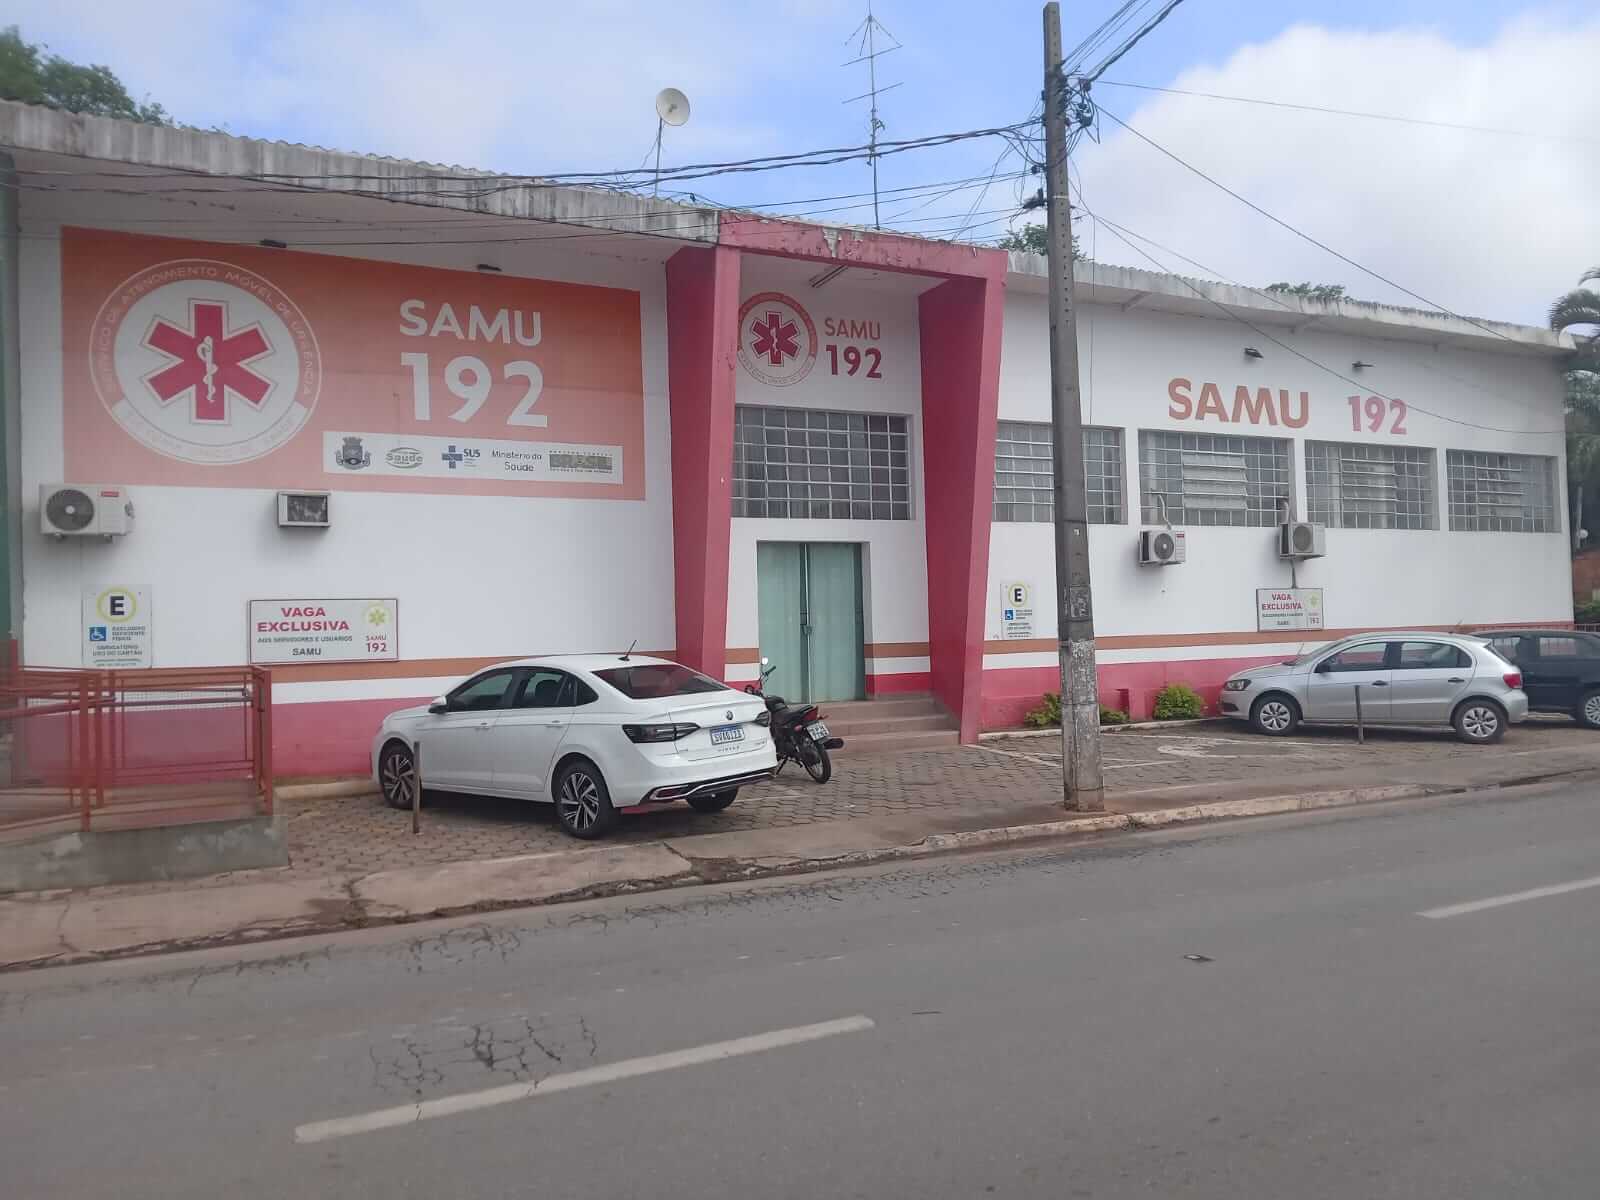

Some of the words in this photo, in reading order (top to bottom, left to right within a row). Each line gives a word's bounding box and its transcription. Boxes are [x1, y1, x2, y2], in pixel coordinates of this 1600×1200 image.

[400, 299, 542, 346] SAMU
[824, 317, 881, 340] SAMU
[825, 345, 882, 378] 192
[400, 352, 548, 428] 192
[1168, 377, 1309, 429] SAMU
[1348, 395, 1407, 435] 192
[463, 448, 480, 459] SUS
[1014, 588, 1022, 602] E
[110, 595, 125, 616] E
[281, 607, 326, 617] VAGA
[1262, 602, 1302, 610] EXCLUSIVA
[257, 621, 349, 632] EXCLUSIVA
[292, 648, 321, 656] SAMU
[367, 642, 387, 652] 192
